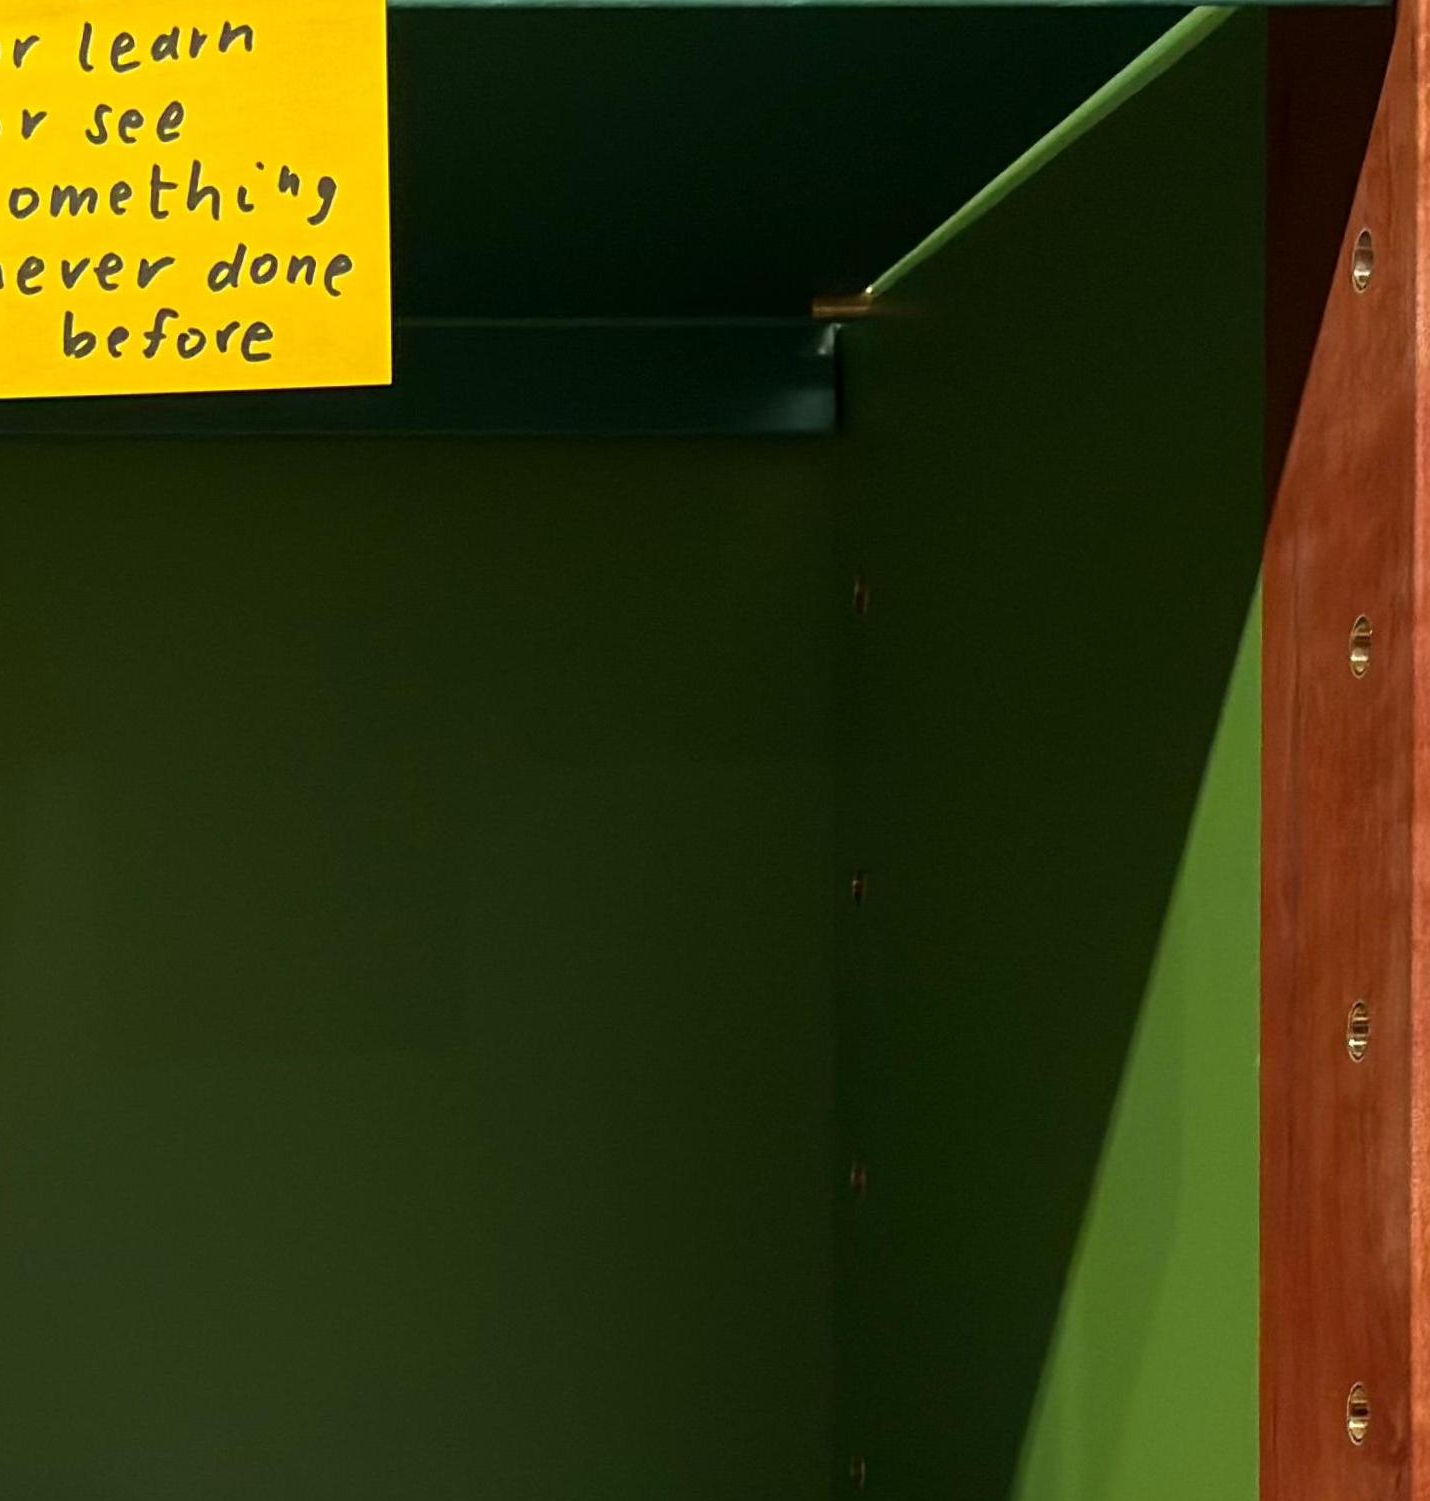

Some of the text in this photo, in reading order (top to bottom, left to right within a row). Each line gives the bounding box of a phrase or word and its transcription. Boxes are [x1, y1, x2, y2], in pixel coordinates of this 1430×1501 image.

[79, 21, 256, 72] learn
[85, 105, 185, 143] see
[207, 244, 354, 292] done
[62, 312, 272, 361] before
